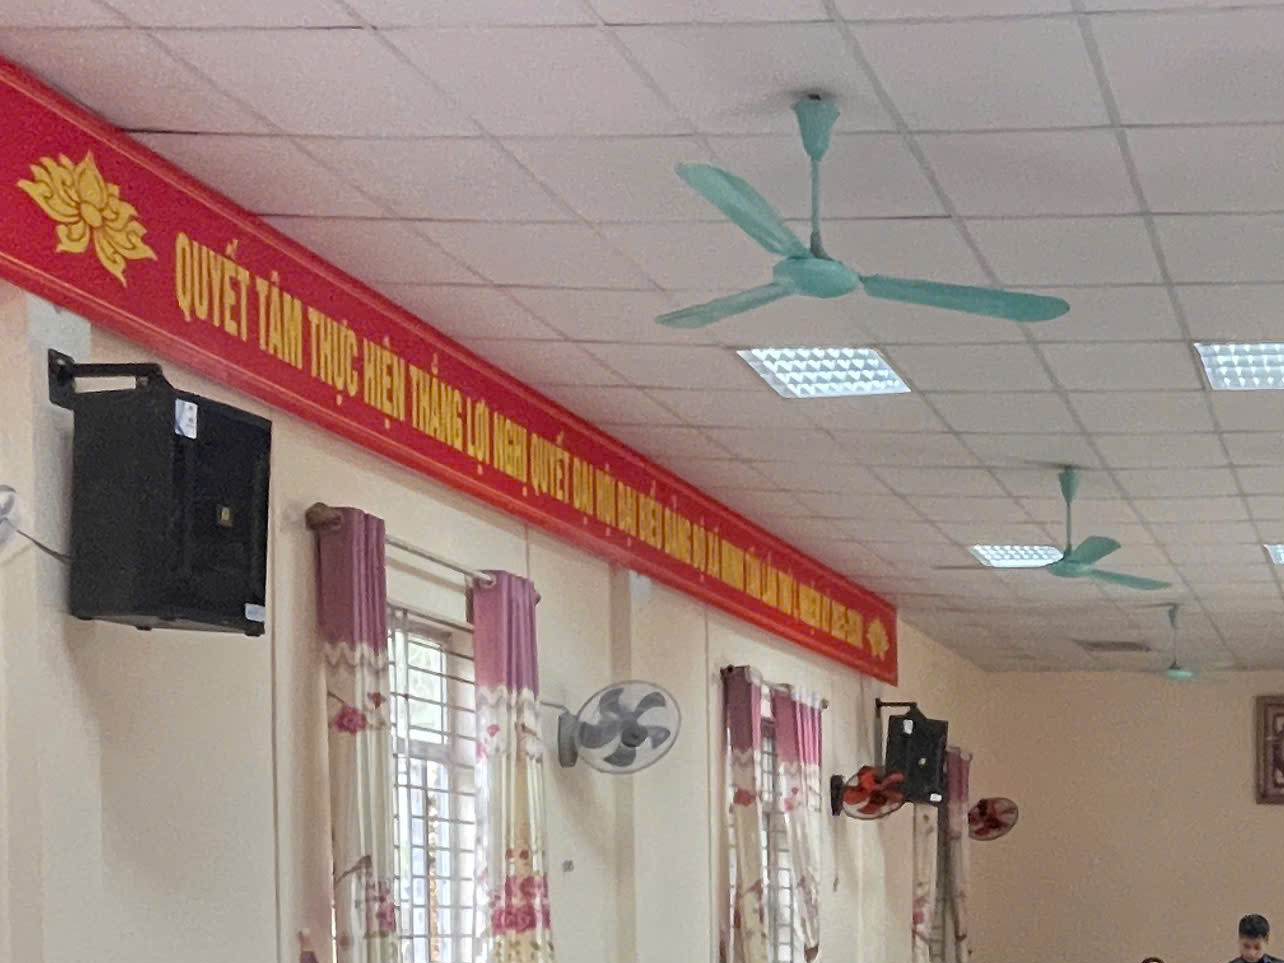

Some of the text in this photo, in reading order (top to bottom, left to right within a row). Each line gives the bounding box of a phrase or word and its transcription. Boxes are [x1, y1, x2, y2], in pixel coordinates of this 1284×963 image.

[175, 232, 250, 342] QUYẾT
[256, 271, 303, 370] TÂM
[308, 307, 359, 405] THỰC
[363, 336, 406, 429] HIỆN
[409, 353, 464, 453] THẮNG
[466, 396, 491, 475] LỢI
[494, 411, 529, 497] NGHỊ
[531, 431, 571, 503] QUYẾT
